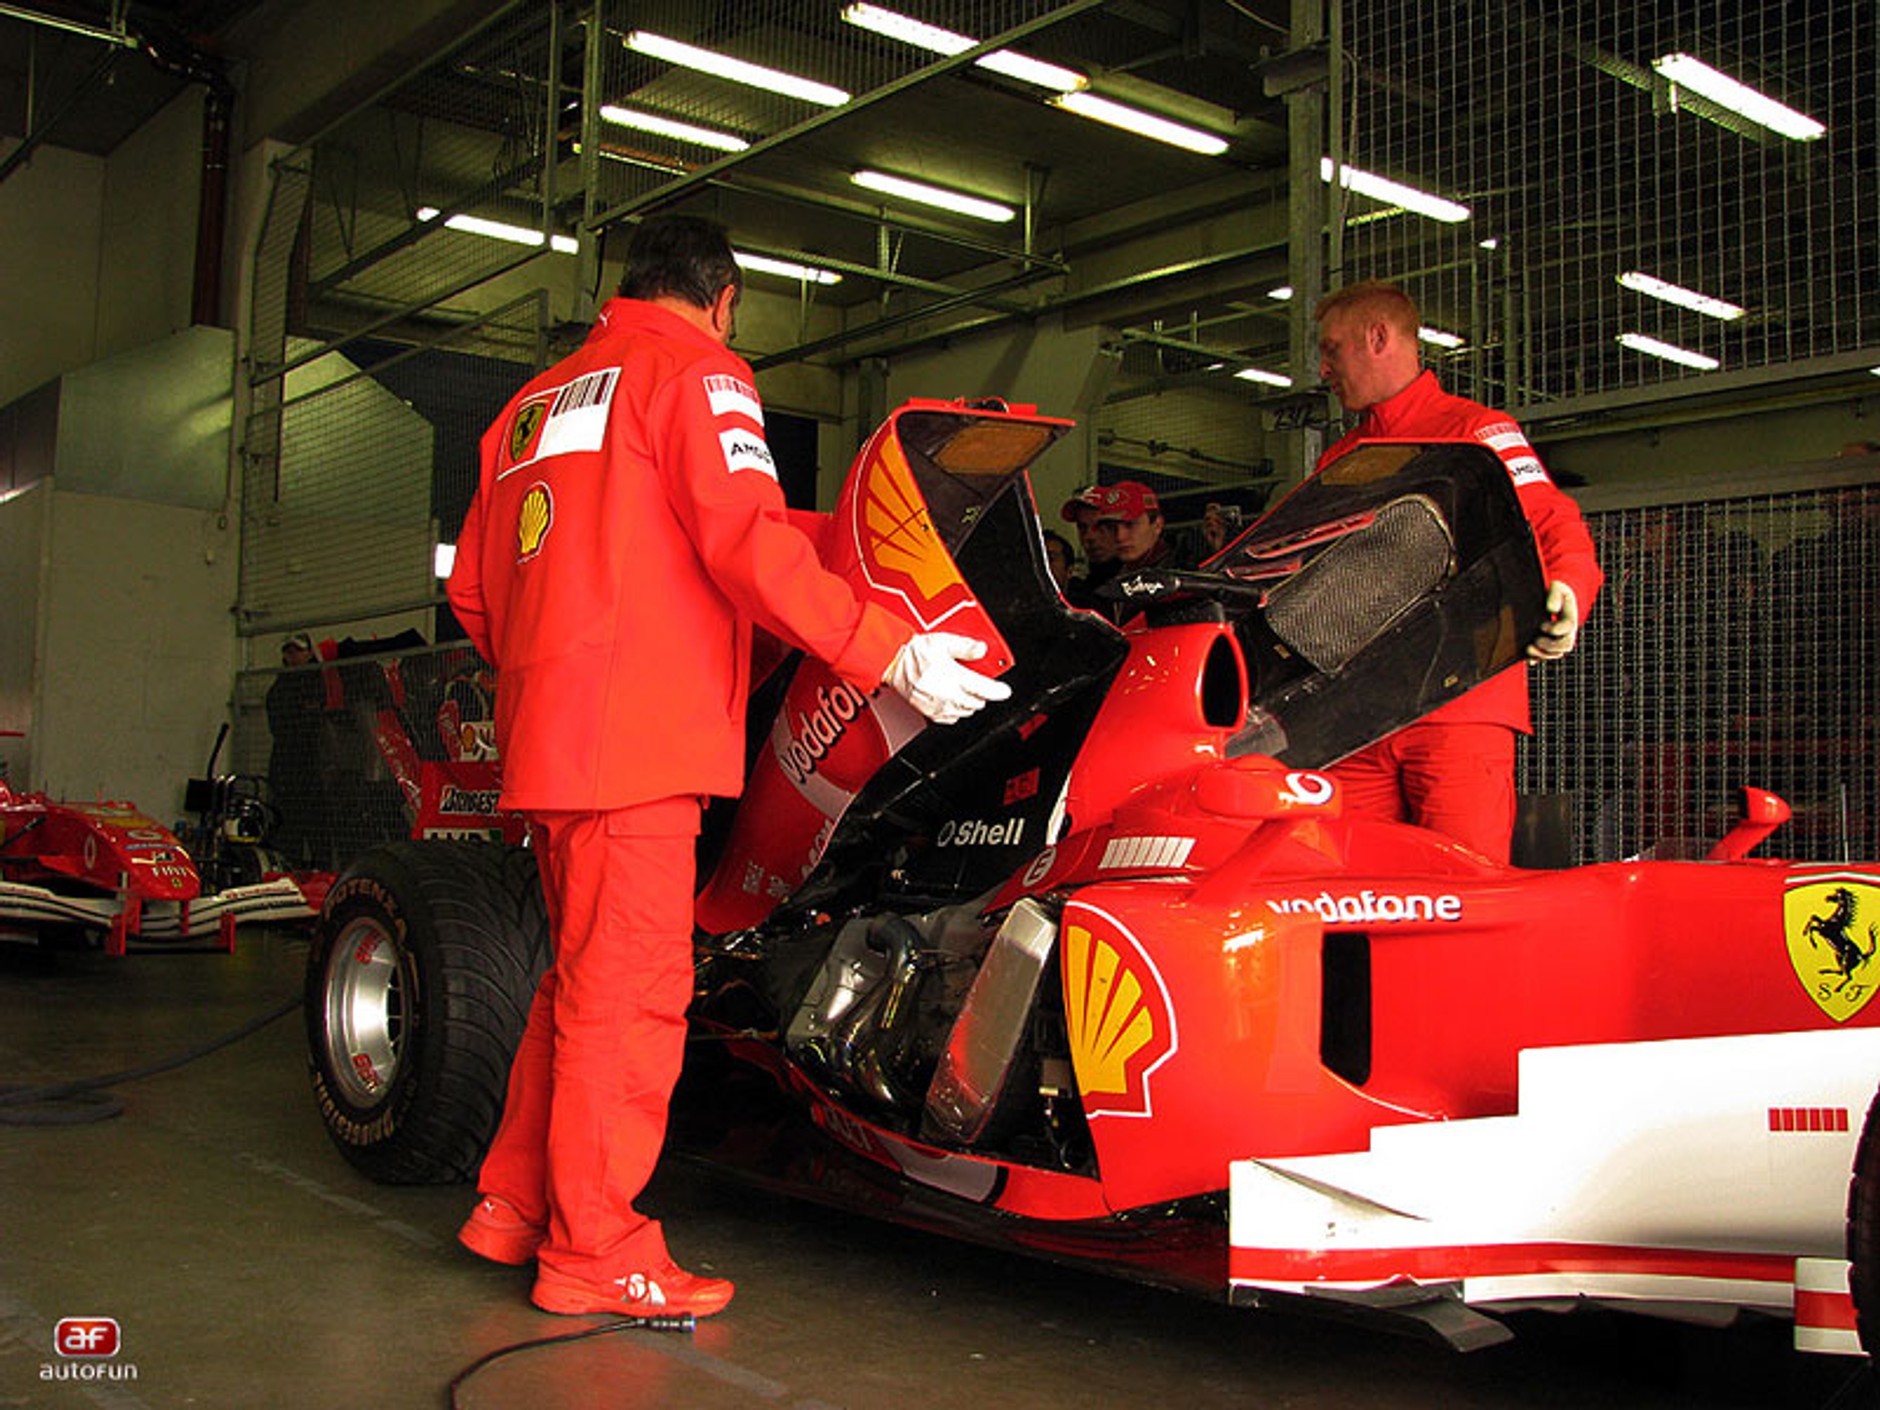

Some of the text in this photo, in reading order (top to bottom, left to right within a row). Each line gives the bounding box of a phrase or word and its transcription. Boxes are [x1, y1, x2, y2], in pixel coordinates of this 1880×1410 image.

[780, 684, 867, 783] vodafo
[954, 818, 1026, 846] Shell
[1267, 890, 1462, 923] vodafone
